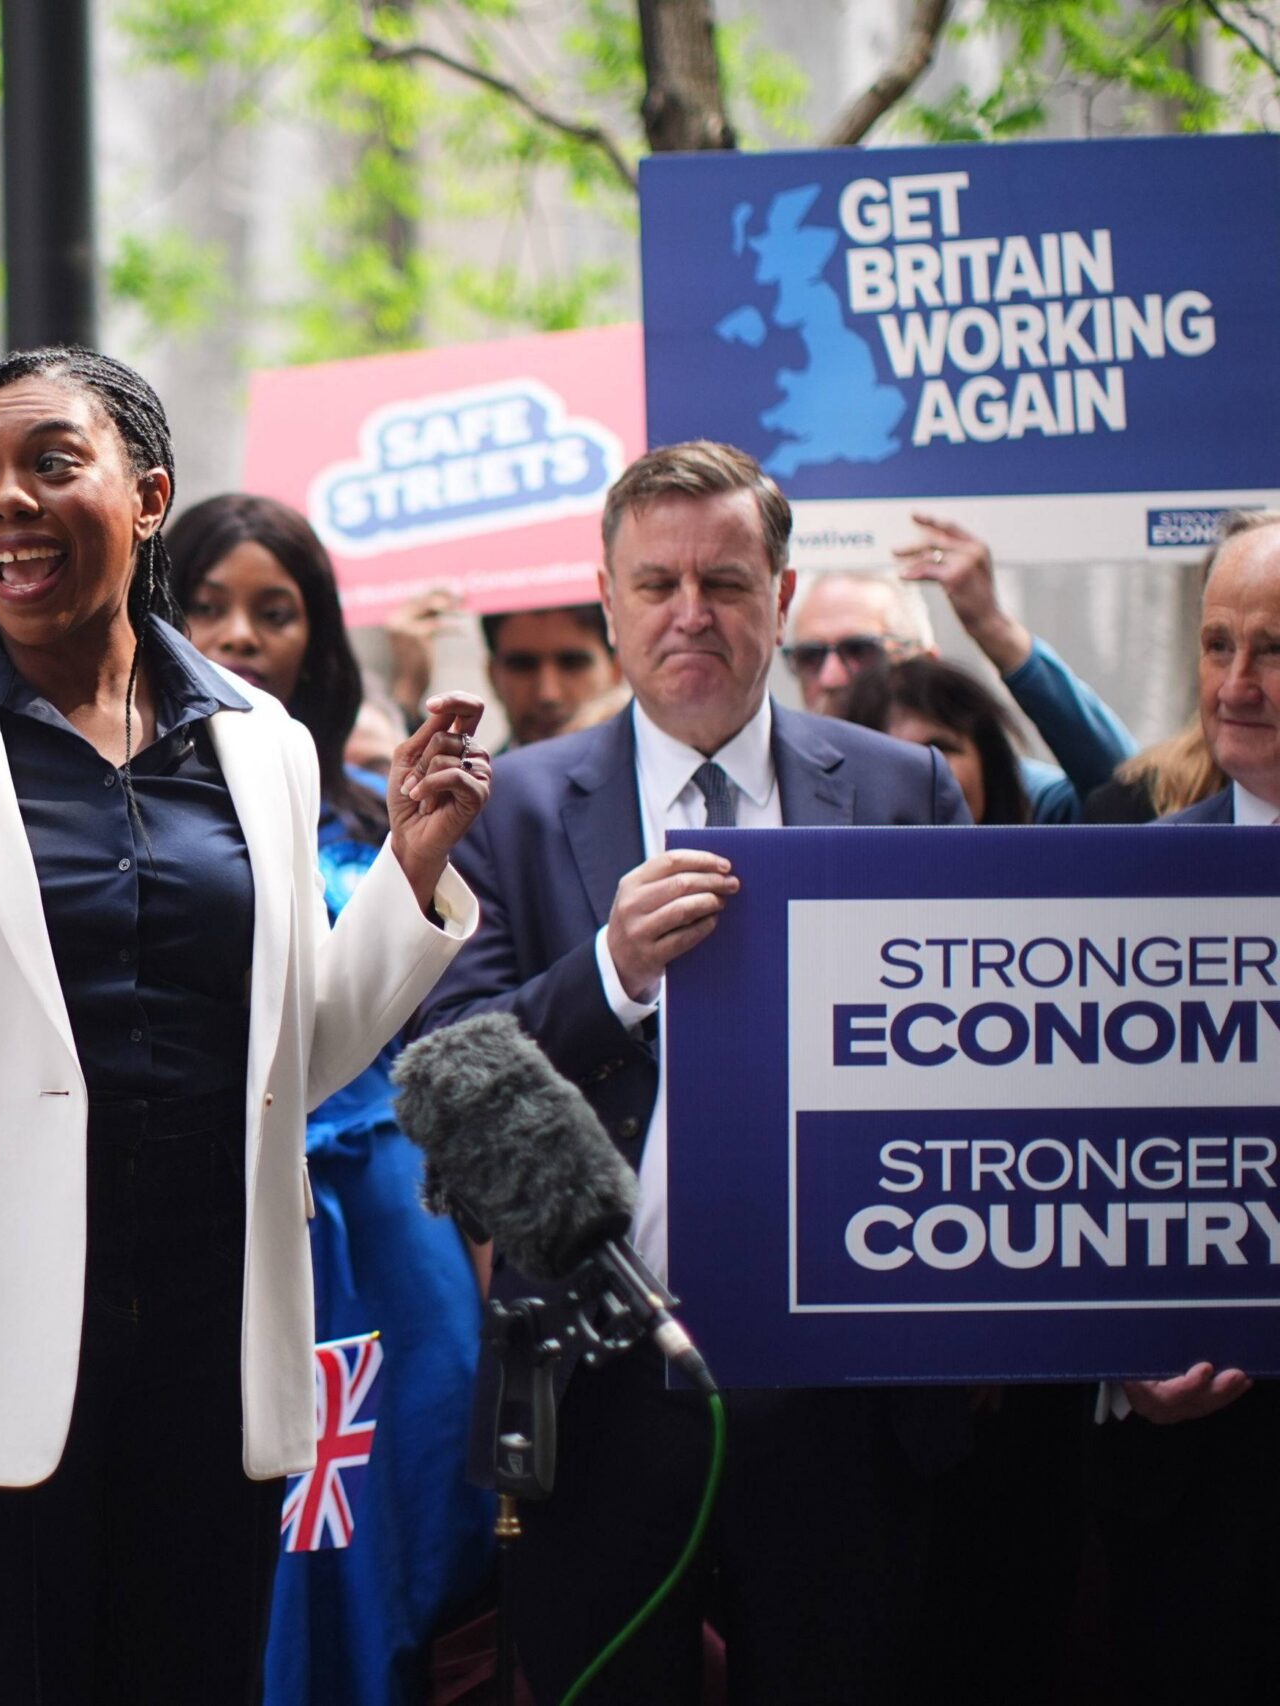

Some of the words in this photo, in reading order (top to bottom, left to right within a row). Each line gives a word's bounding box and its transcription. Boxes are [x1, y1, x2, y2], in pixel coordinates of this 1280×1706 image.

[839, 170, 969, 245] GET
[846, 229, 1114, 314] BRITAIN
[878, 291, 1216, 378] WORKING
[383, 397, 533, 464] SAFE
[912, 367, 1126, 447] AGAIN
[330, 437, 590, 528] STREETS
[879, 936, 1278, 989] STRONGER
[878, 1137, 1277, 1193] STRONGER
